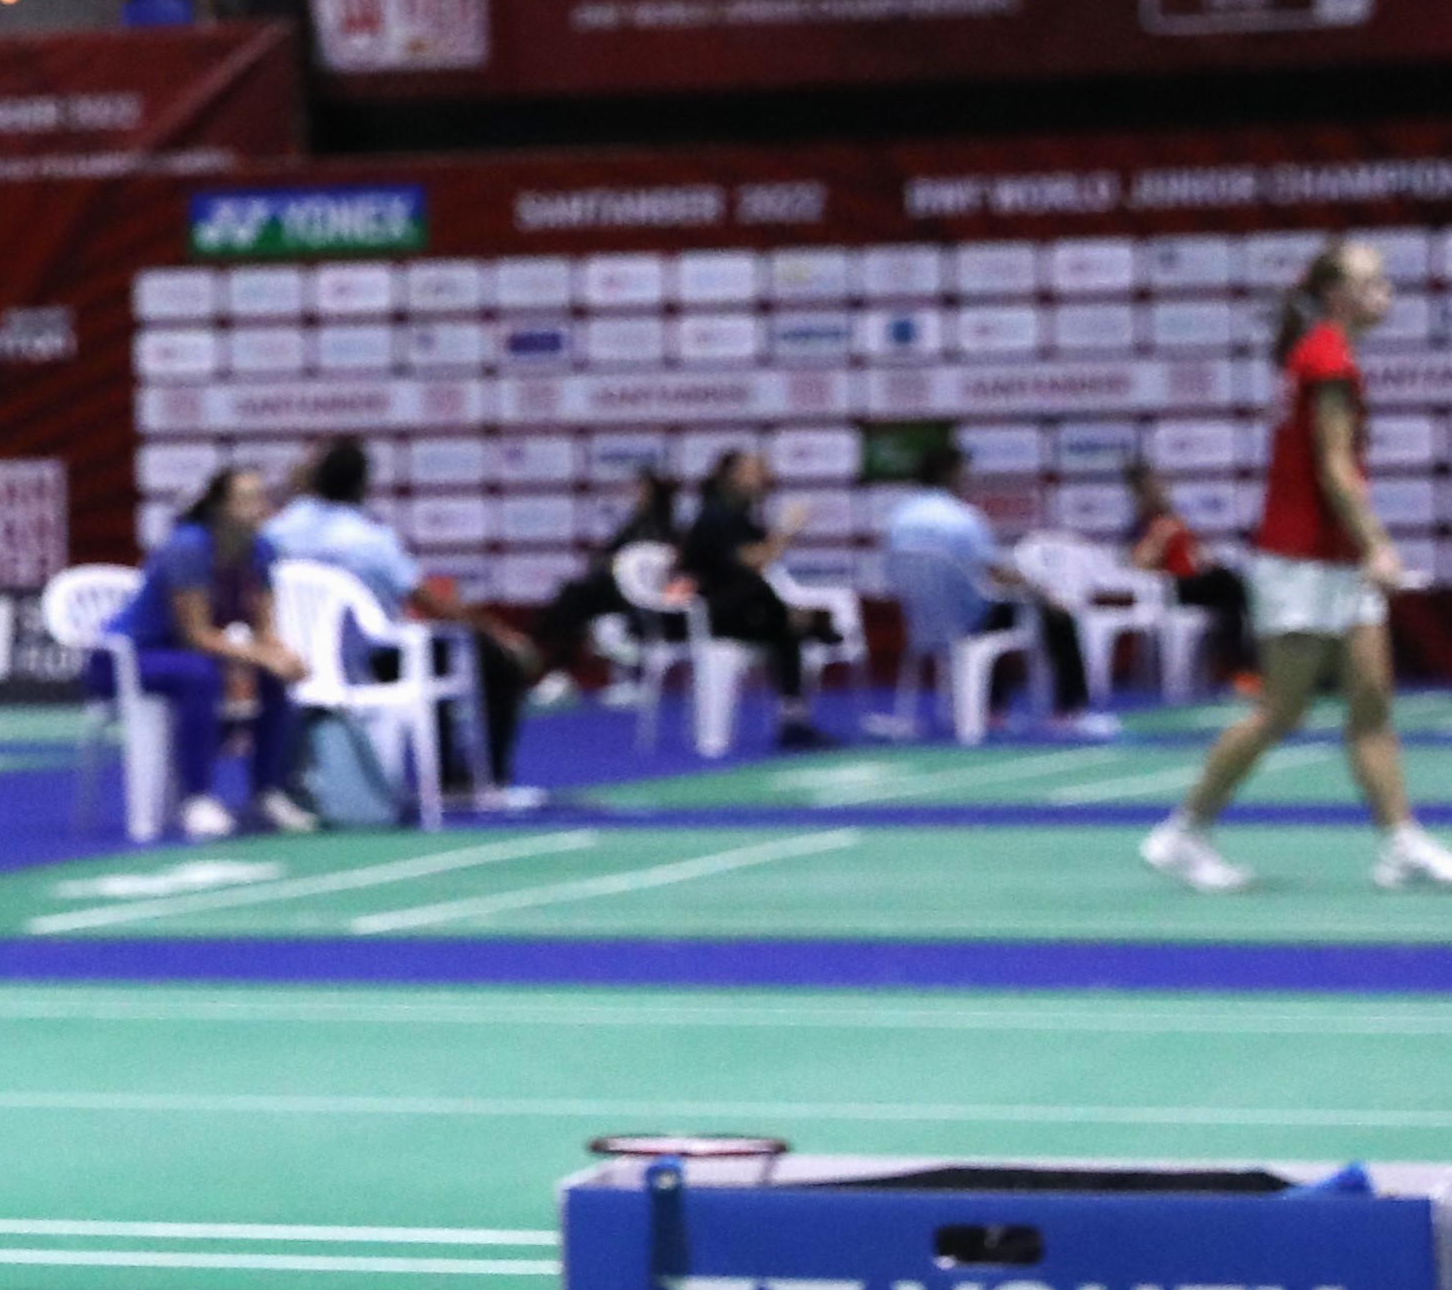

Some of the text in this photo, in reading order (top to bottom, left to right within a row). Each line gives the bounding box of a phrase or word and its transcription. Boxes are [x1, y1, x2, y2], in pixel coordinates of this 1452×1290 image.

[512, 185, 728, 232] SANTANDER
[993, 170, 1124, 214] WORLD
[284, 191, 411, 242] YONEX
